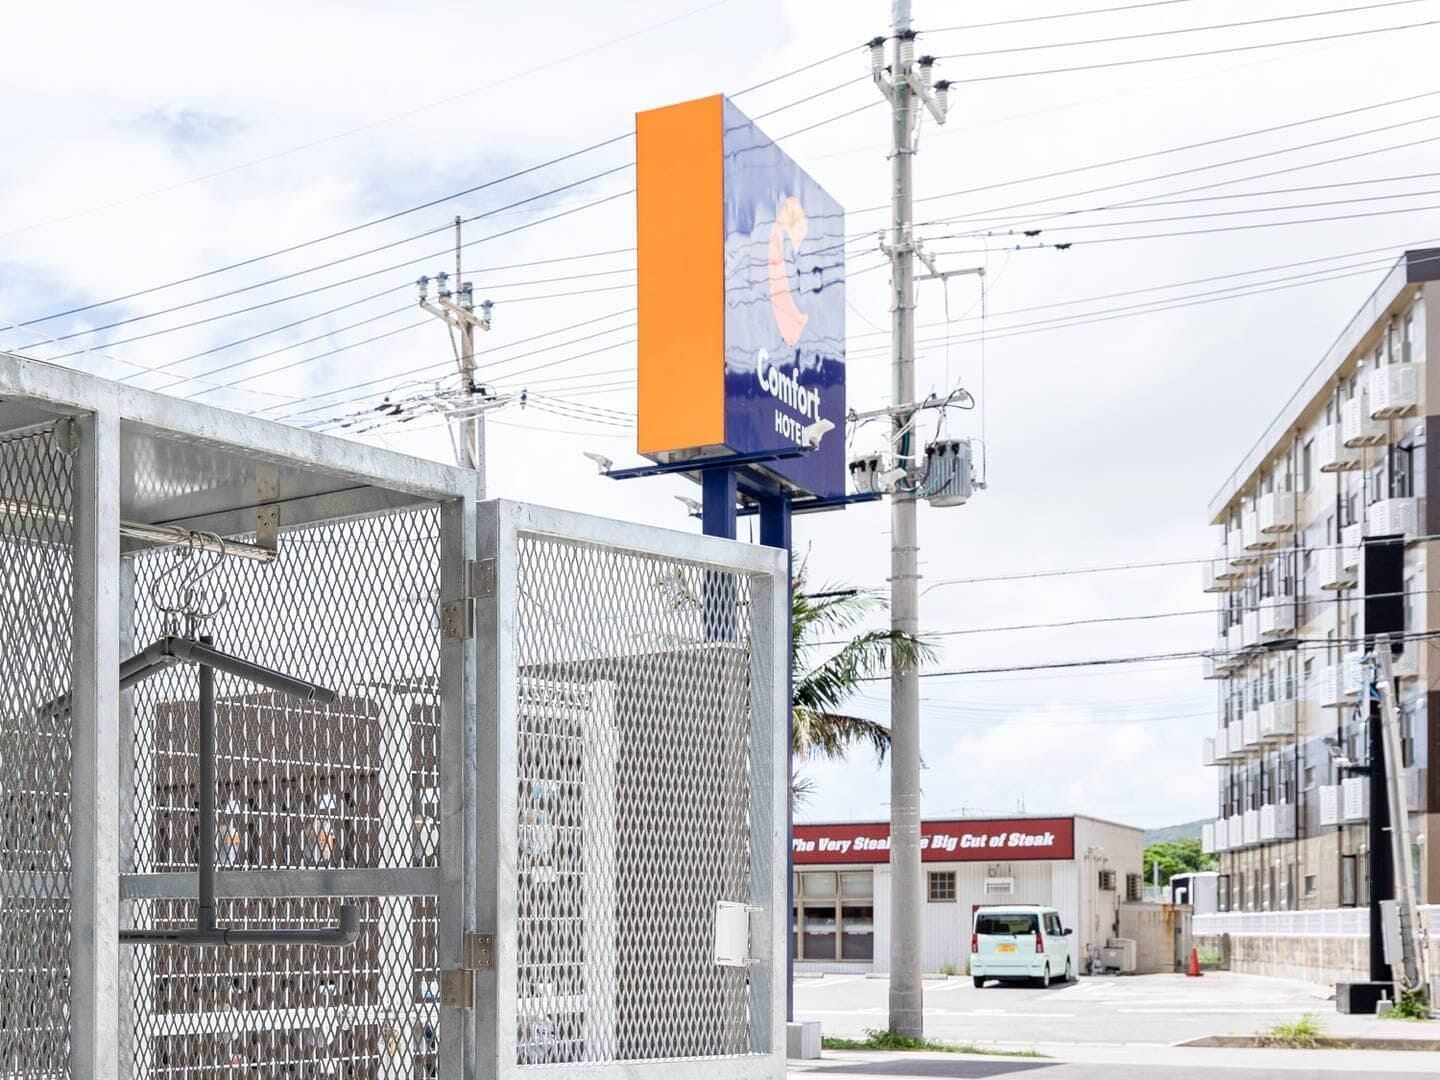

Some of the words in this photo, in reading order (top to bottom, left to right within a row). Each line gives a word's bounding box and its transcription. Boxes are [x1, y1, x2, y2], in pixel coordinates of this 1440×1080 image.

[757, 347, 820, 422] Comfort
[818, 838, 852, 853] Very
[931, 834, 958, 851] Big
[960, 834, 987, 848] Cut
[989, 833, 1007, 847] of
[1008, 832, 1054, 847] Steak
